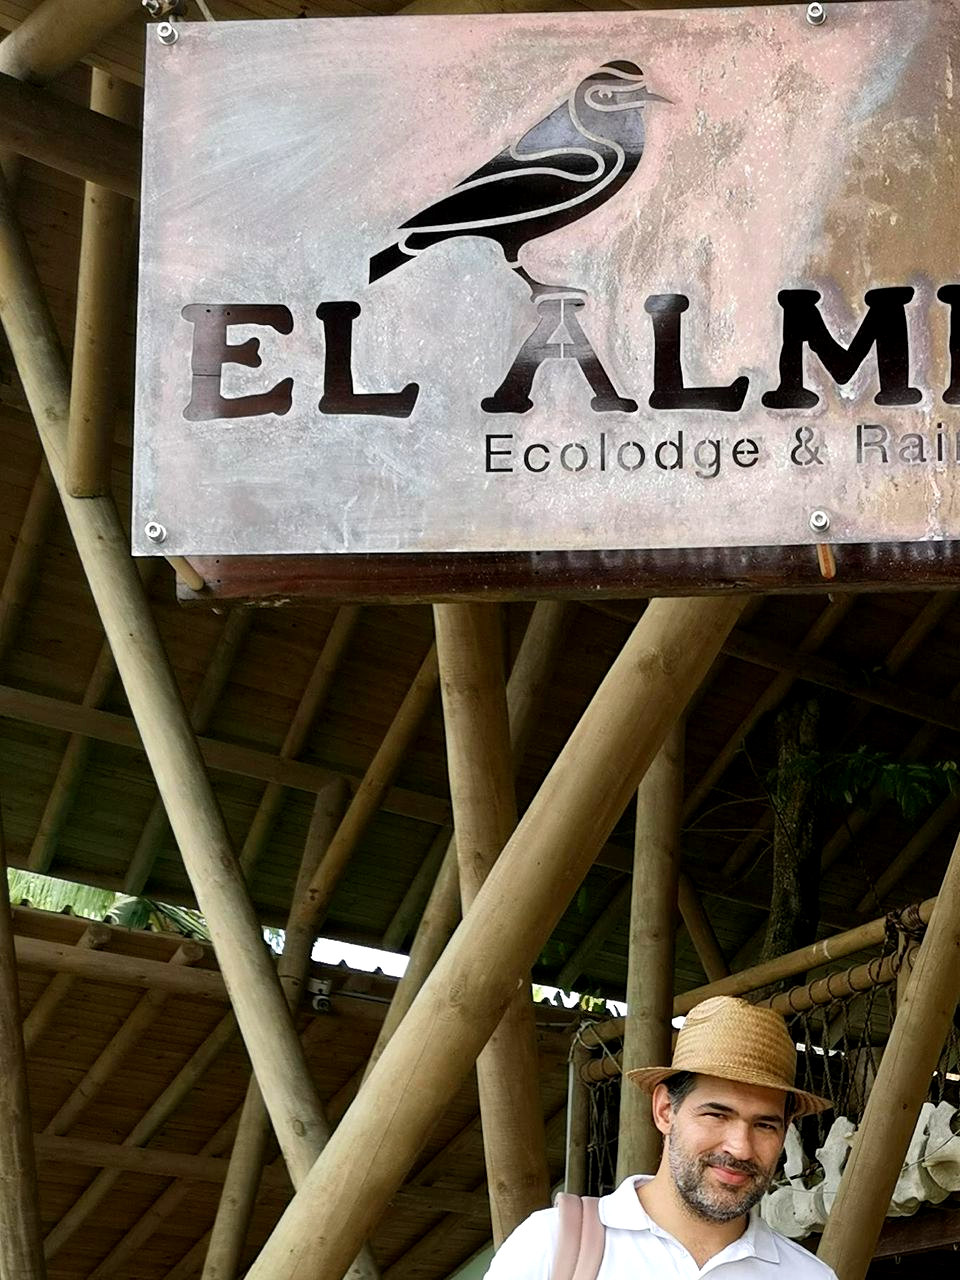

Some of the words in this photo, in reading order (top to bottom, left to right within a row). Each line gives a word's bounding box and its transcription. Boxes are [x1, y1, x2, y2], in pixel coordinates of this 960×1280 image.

[180, 300, 420, 422] EL
[484, 431, 760, 479] Ecolodge
[790, 426, 825, 467] &
